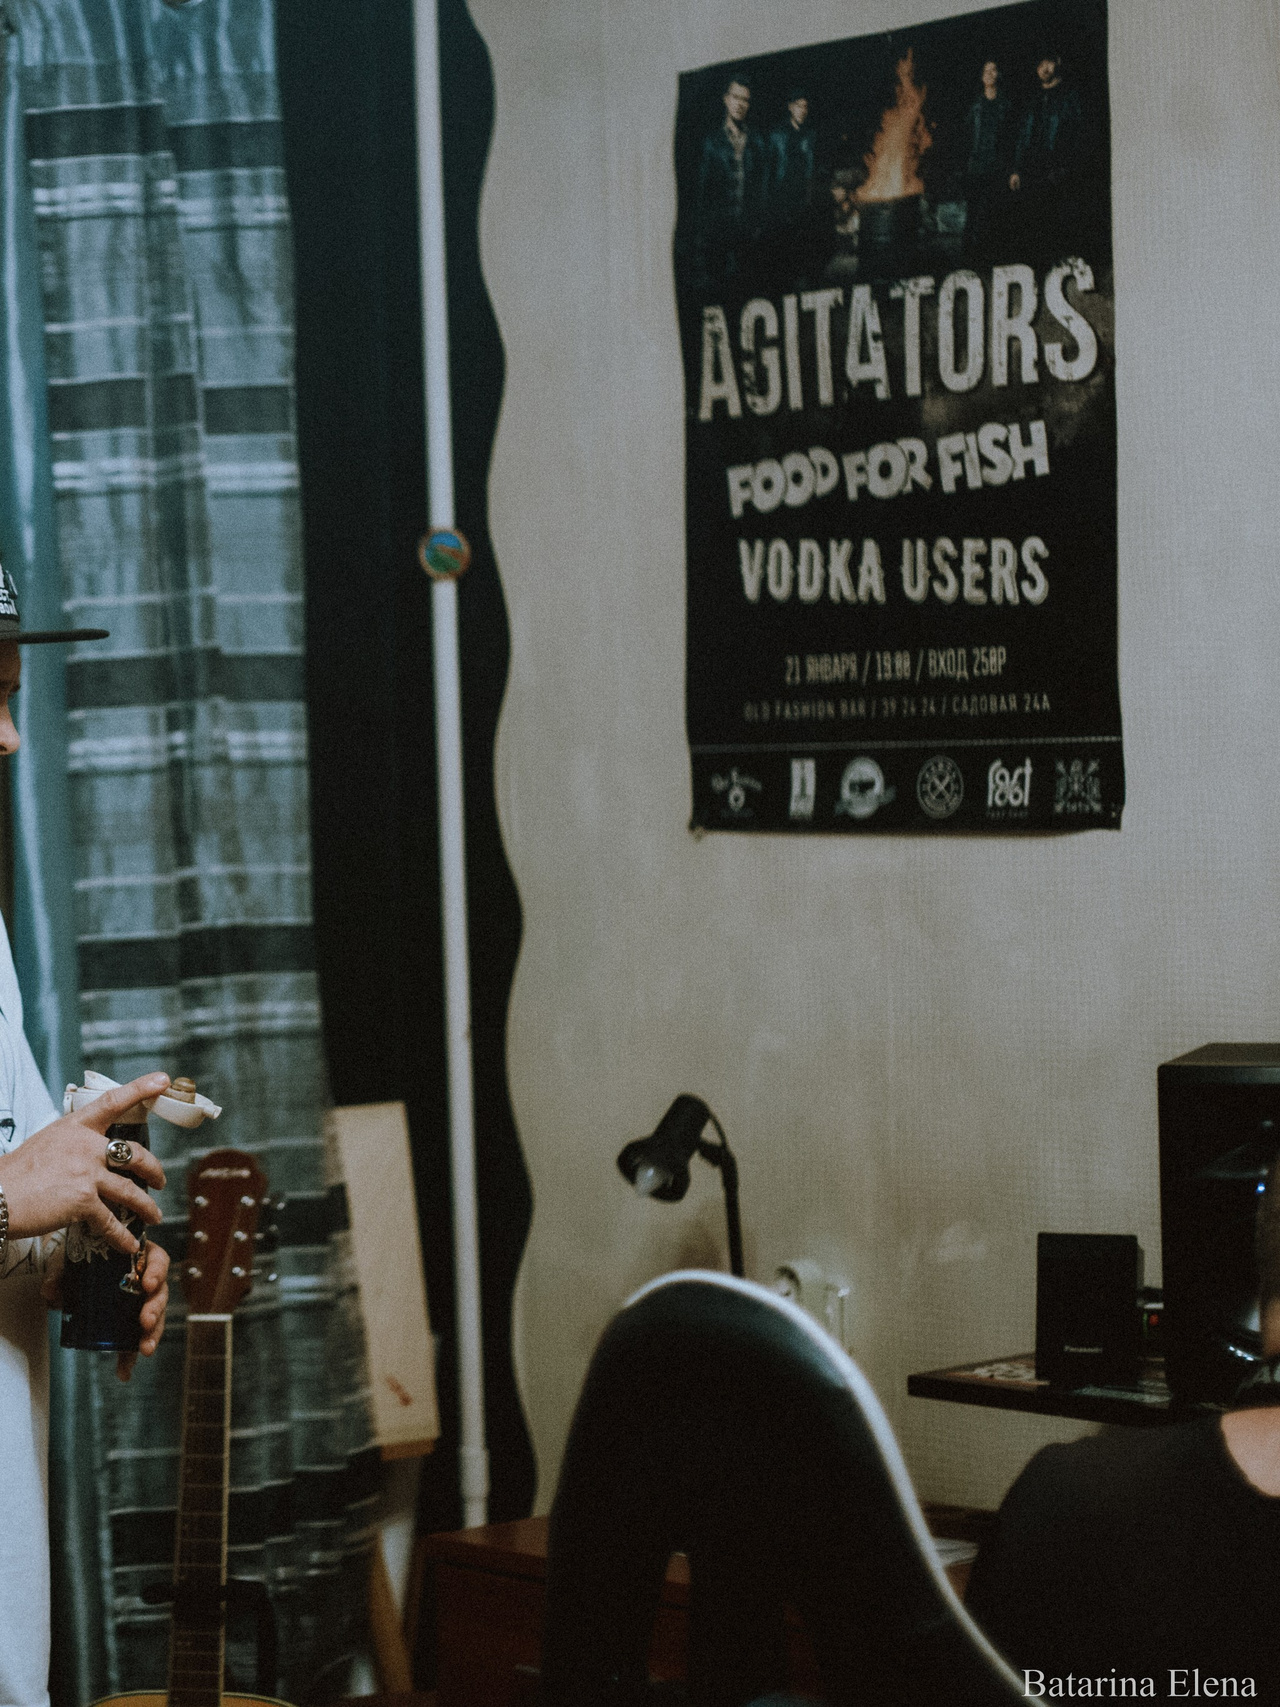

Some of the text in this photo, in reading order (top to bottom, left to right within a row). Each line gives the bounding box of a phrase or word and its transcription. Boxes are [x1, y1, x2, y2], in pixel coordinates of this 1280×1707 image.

[699, 256, 1098, 421] AGITATORS
[727, 420, 1050, 519] FOOD FOR FISH
[738, 535, 1050, 605] VODKA USERS
[785, 655, 801, 685] 21
[805, 652, 858, 683] ЯНВАРЯ
[927, 647, 969, 681] ВХОД
[951, 693, 1018, 717] САДОВАЯ
